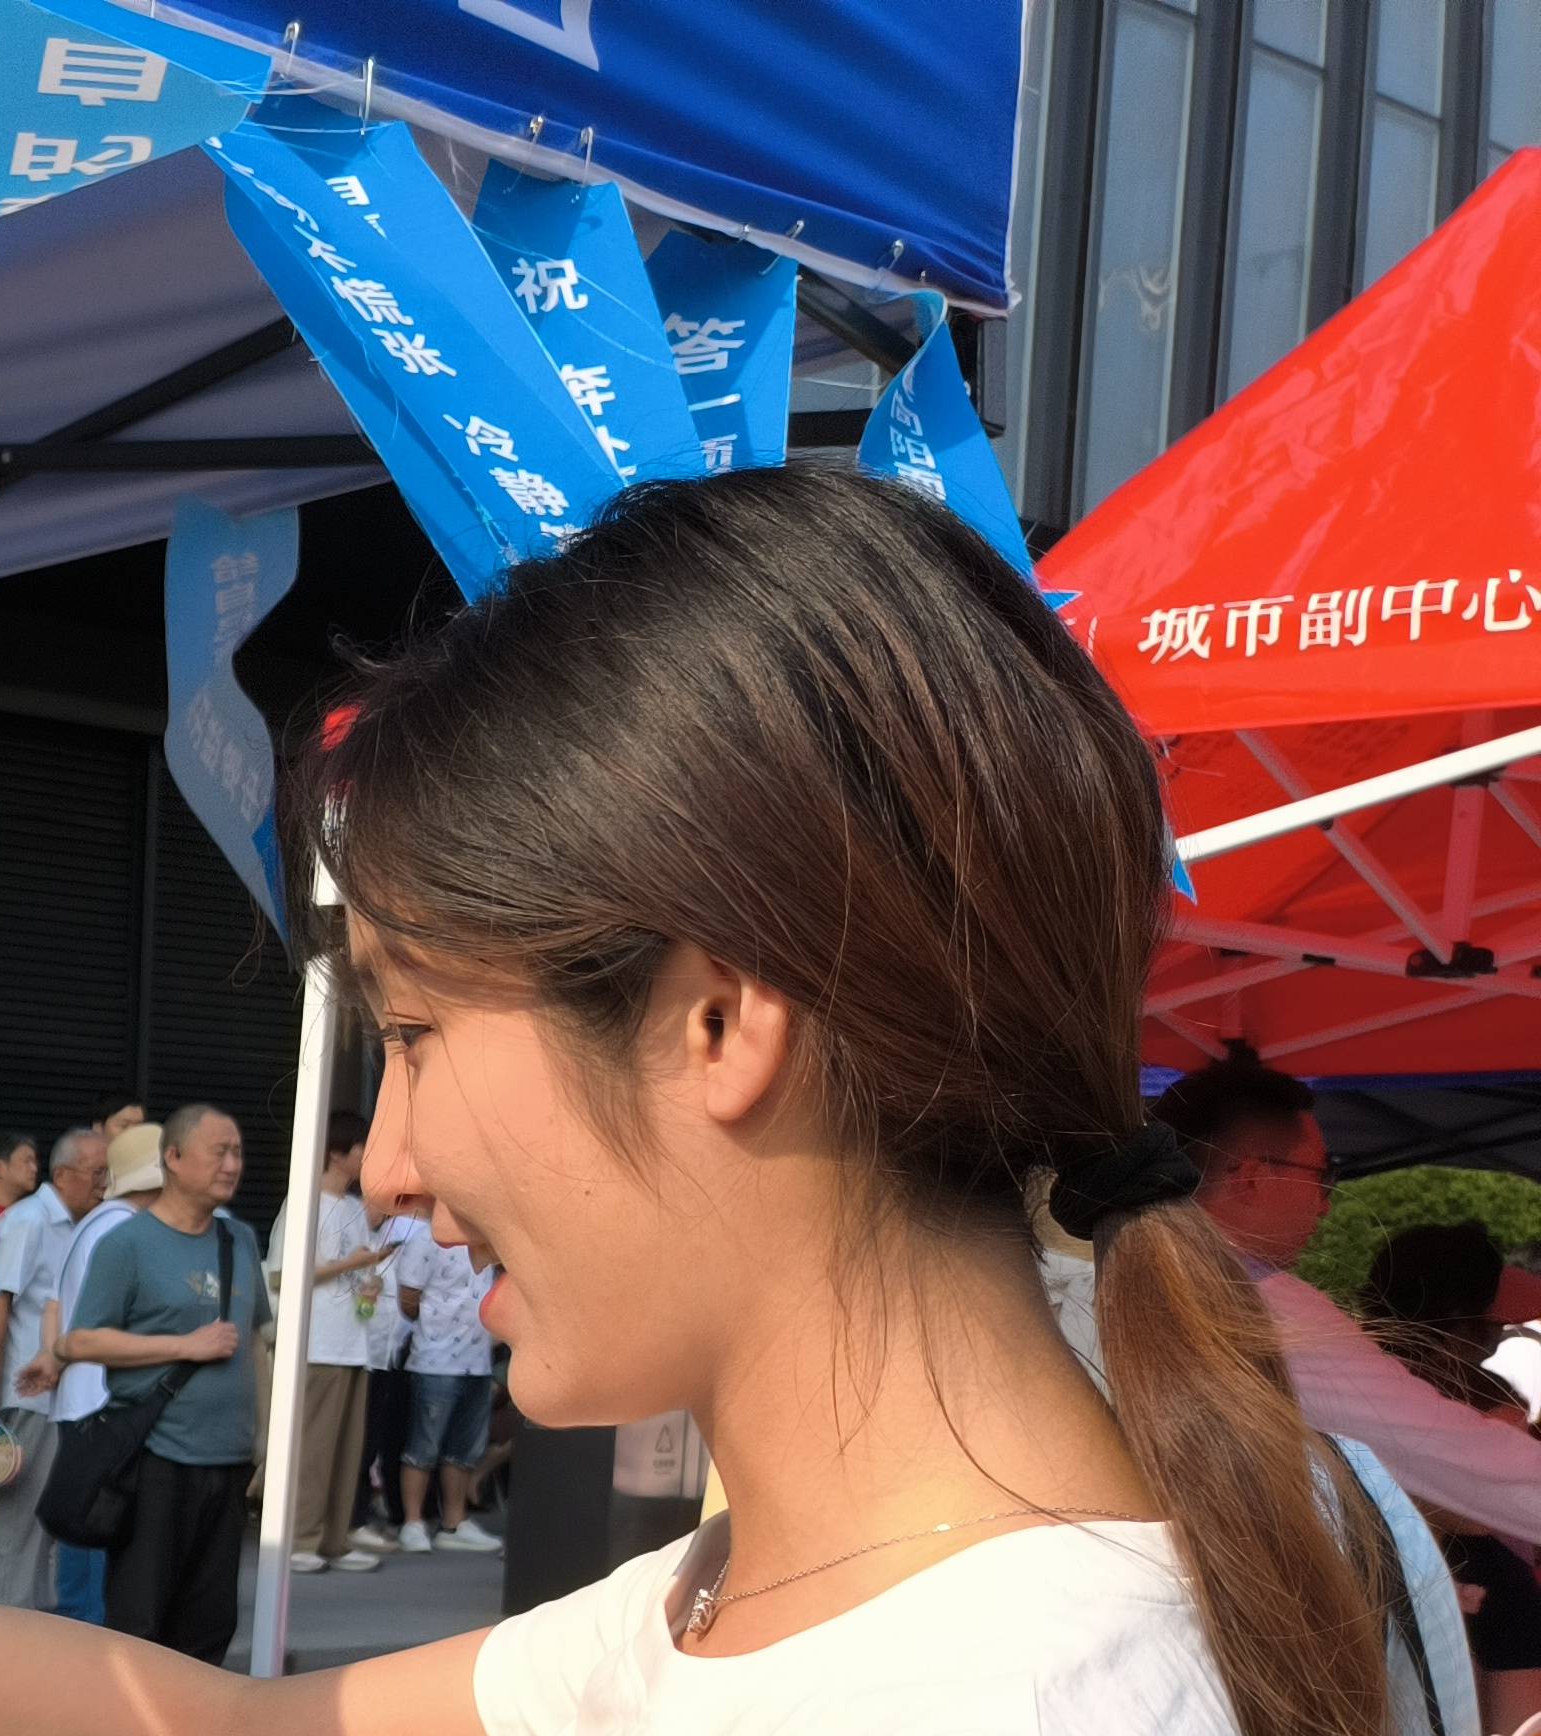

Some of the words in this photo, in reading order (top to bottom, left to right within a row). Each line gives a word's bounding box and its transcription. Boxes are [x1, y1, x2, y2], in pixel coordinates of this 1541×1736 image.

[510, 257, 588, 314] 祝
[1138, 567, 1541, 665] 城市副中心
